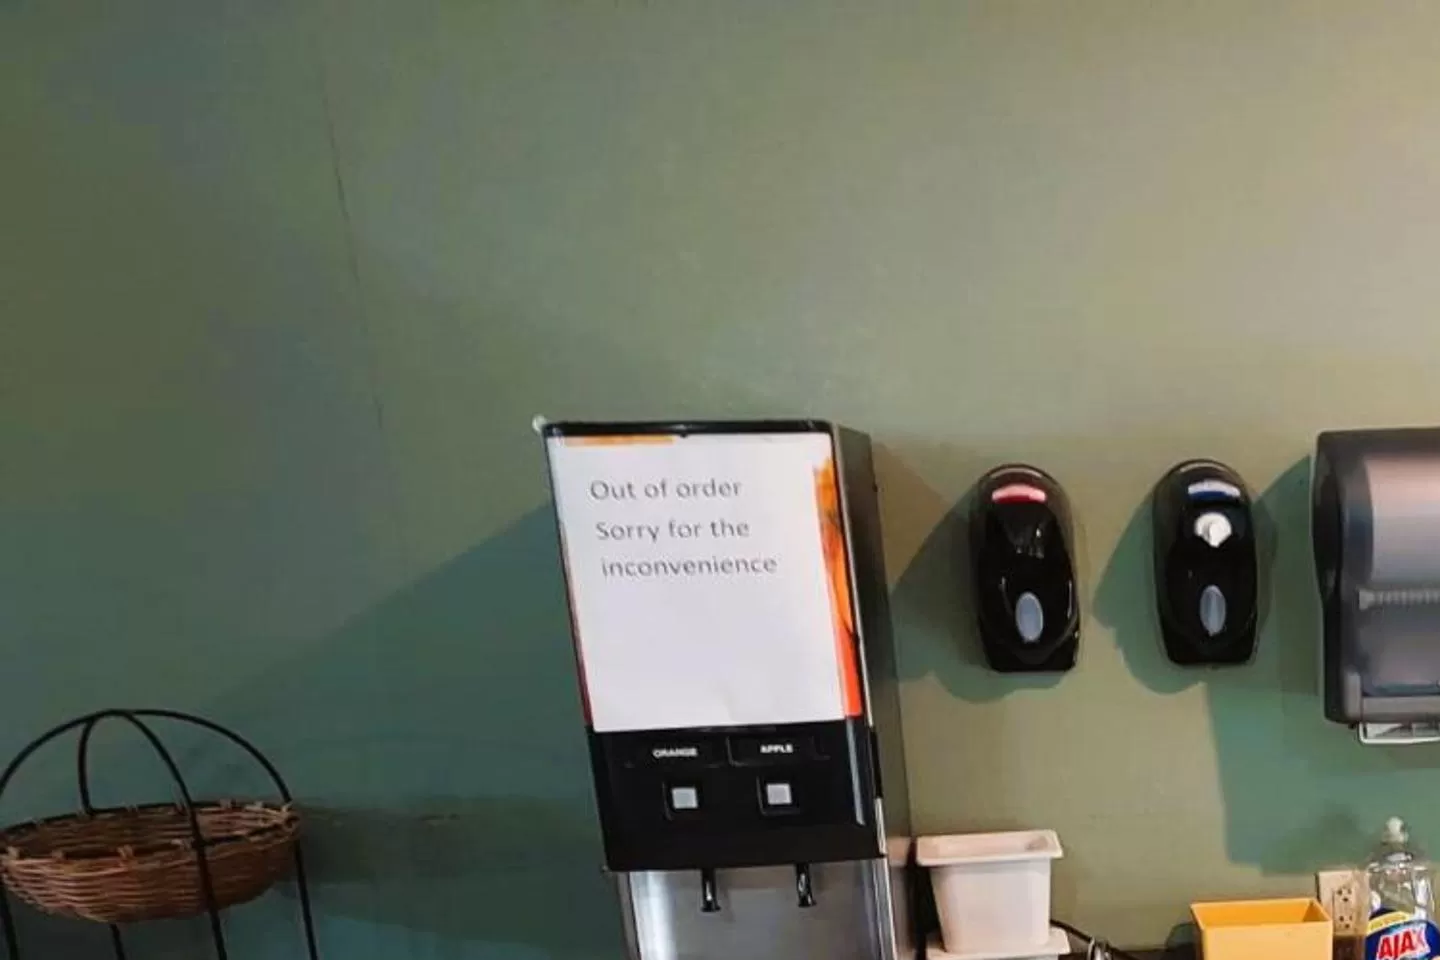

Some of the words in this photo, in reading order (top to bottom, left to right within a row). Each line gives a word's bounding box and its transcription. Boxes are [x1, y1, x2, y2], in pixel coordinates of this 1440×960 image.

[590, 479, 636, 500] Out
[643, 478, 668, 499] of
[675, 478, 742, 498] order
[596, 520, 660, 543] Sorry
[669, 517, 700, 538] for
[710, 518, 750, 538] the
[602, 555, 778, 577] inconvenience
[652, 747, 698, 758] ORANGE
[760, 743, 793, 753] APPLE
[1378, 926, 1427, 960] AJAX
